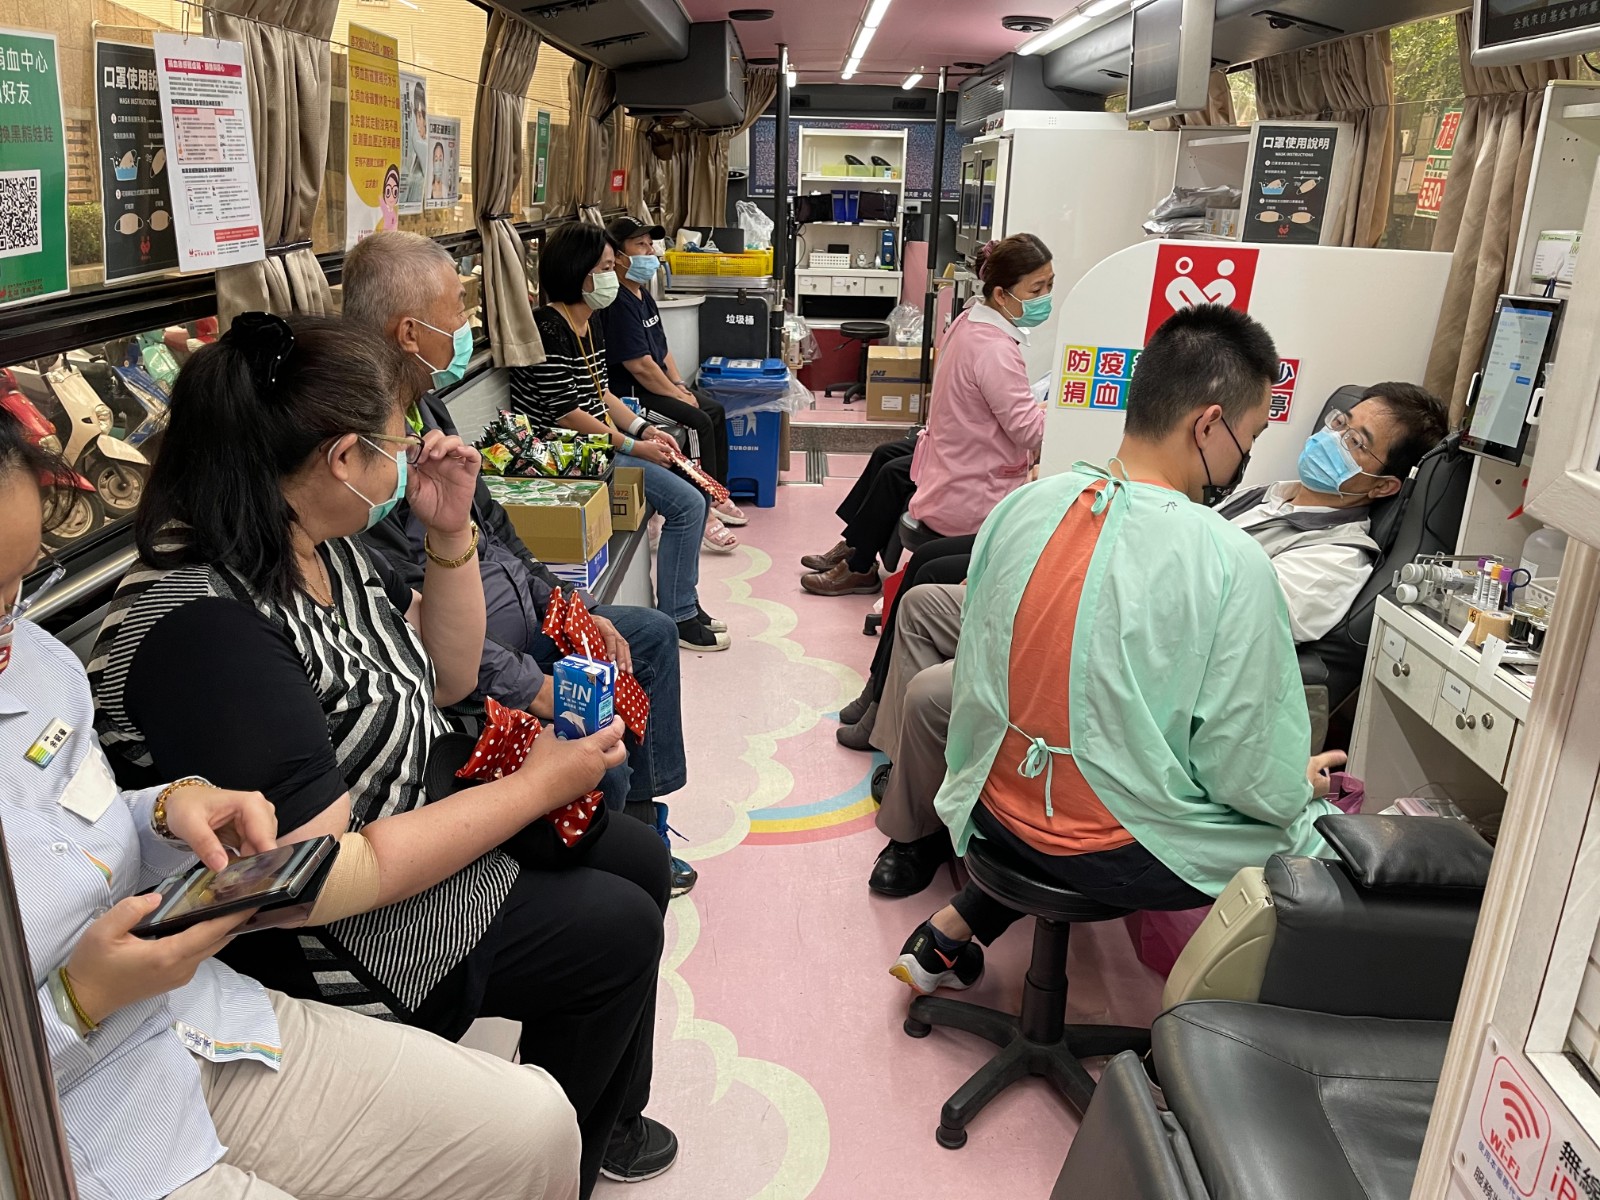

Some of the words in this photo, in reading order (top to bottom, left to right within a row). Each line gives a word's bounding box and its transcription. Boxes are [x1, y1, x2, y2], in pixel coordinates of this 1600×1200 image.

[0, 80, 31, 104] 好友
[1263, 136, 1330, 150] 口罩使用說明
[726, 314, 754, 325] 垃圾桶
[1067, 350, 1143, 376] 防疫
[1063, 381, 1120, 406] 捐血
[558, 680, 592, 703] FIN
[1490, 1128, 1520, 1180] Wi-Fi
